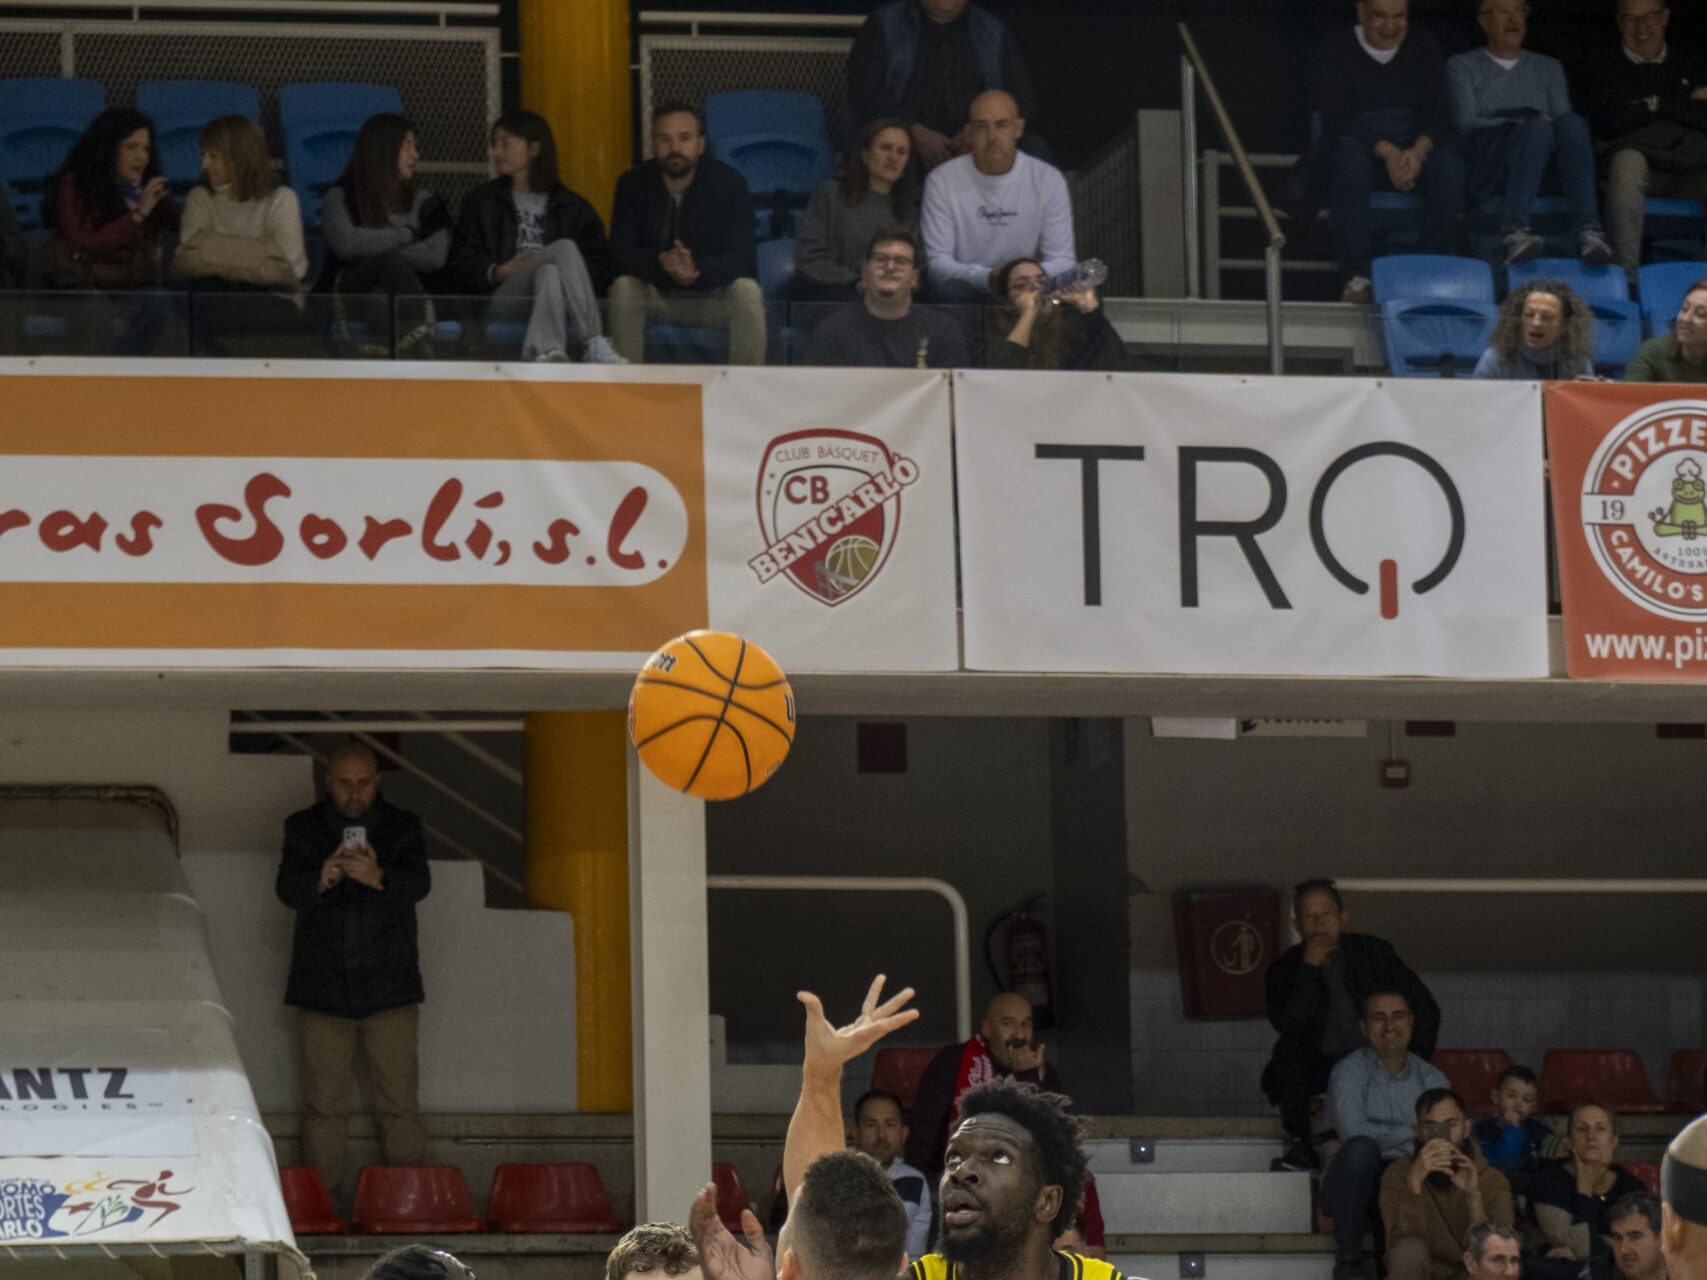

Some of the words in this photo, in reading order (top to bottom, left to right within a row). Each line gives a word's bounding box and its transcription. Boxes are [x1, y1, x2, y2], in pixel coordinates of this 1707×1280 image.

[775, 446, 811, 463] CLUB
[816, 443, 879, 463] BÀSQUET
[784, 475, 830, 504] CB
[747, 452, 920, 584] BENICARLÓ
[1600, 499, 1626, 521] 19
[1611, 529, 1704, 602] CAMILO'S
